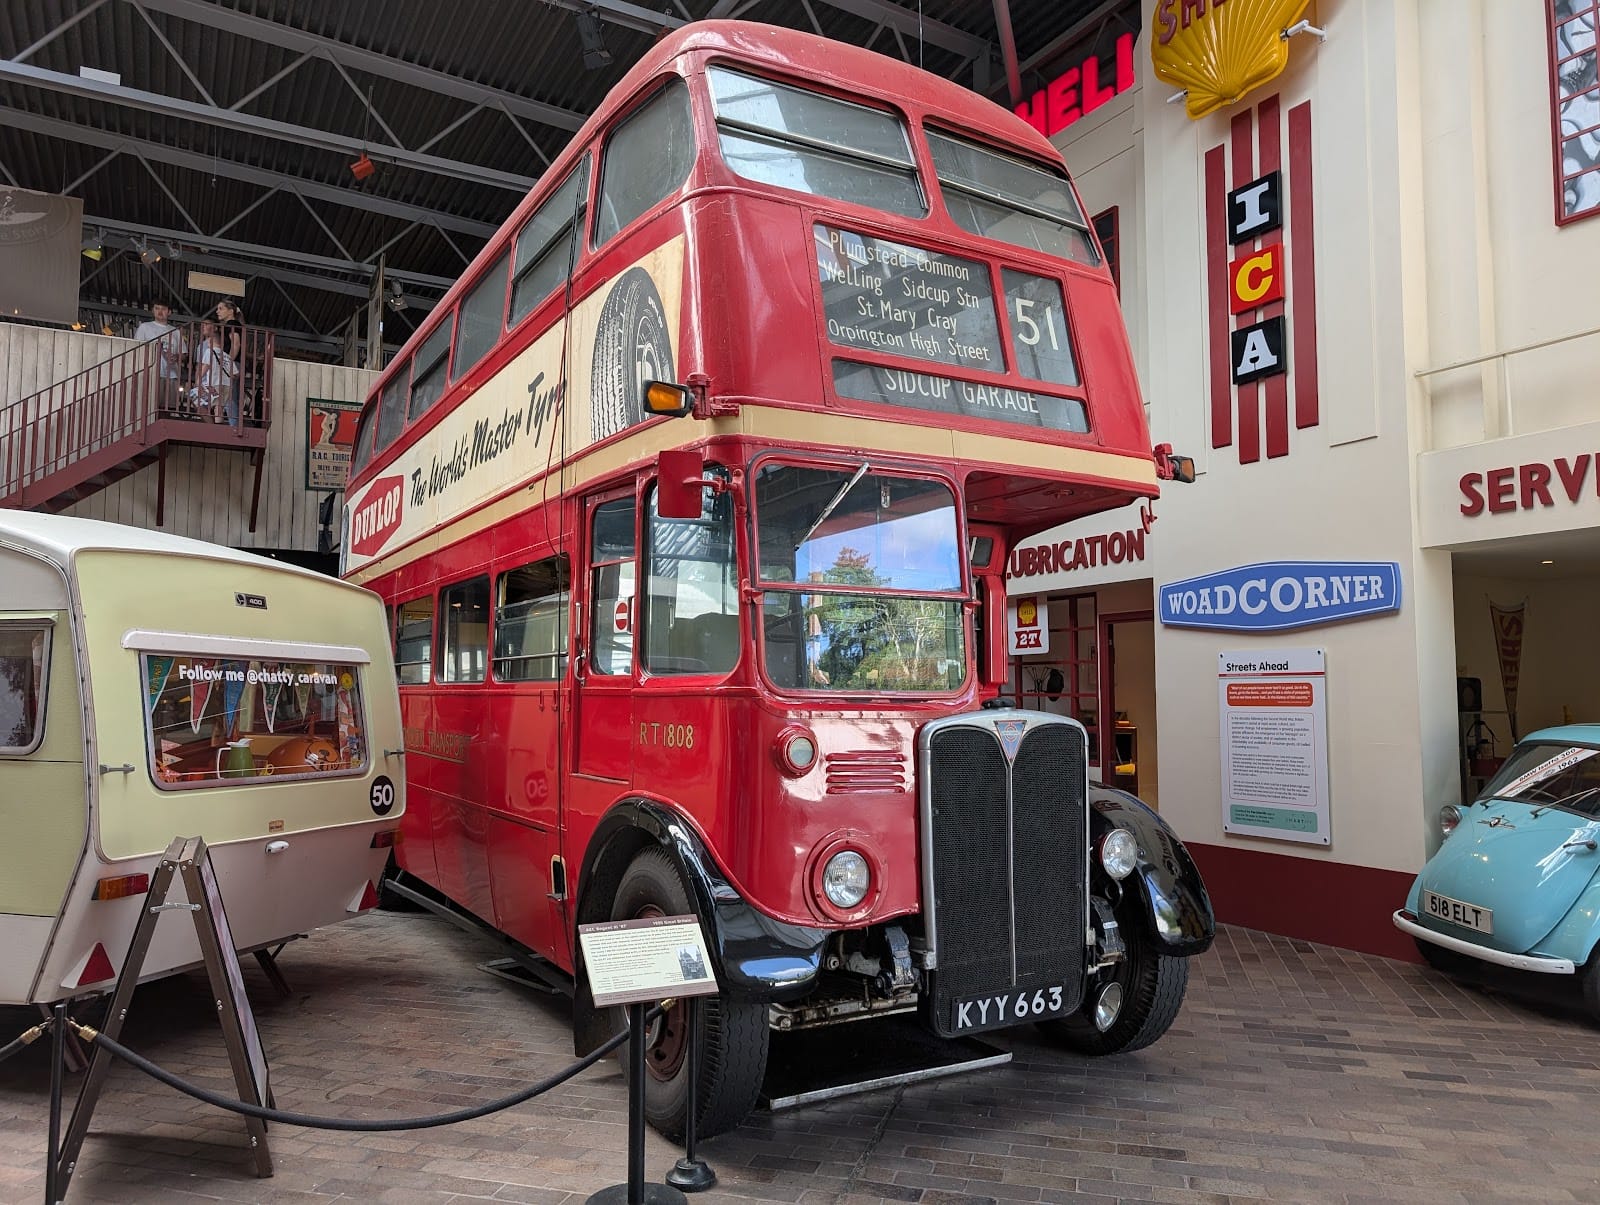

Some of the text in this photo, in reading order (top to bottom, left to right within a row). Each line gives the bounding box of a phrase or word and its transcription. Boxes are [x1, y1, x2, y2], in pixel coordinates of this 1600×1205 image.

[1158, 0, 1229, 45] SH
[830, 231, 969, 282] Plumstead Common
[823, 261, 980, 309] Welling Sidcup Stn
[828, 319, 991, 361] Orpington High Street
[928, 307, 957, 336] Cray
[1014, 297, 1059, 351] 51
[885, 367, 1039, 414] SIDCUP GARAGE
[410, 467, 427, 508] The
[428, 433, 469, 498] World's
[469, 407, 523, 470] Master
[354, 485, 401, 546] DUNLOP
[1006, 528, 1146, 579] UBRICATION
[1168, 575, 1385, 616] WOADCORNER
[1019, 632, 1038, 646] 2T
[178, 664, 223, 681] Follow
[225, 670, 245, 682] me
[247, 668, 338, 687] @chatty_caravan
[1226, 660, 1289, 672] Streets Ahead
[1518, 768, 1537, 782] BMW
[1558, 756, 1579, 771] 1962
[372, 784, 394, 807] 50
[1430, 895, 1482, 927] 518 ELT
[957, 986, 1063, 1029] KYY 663
